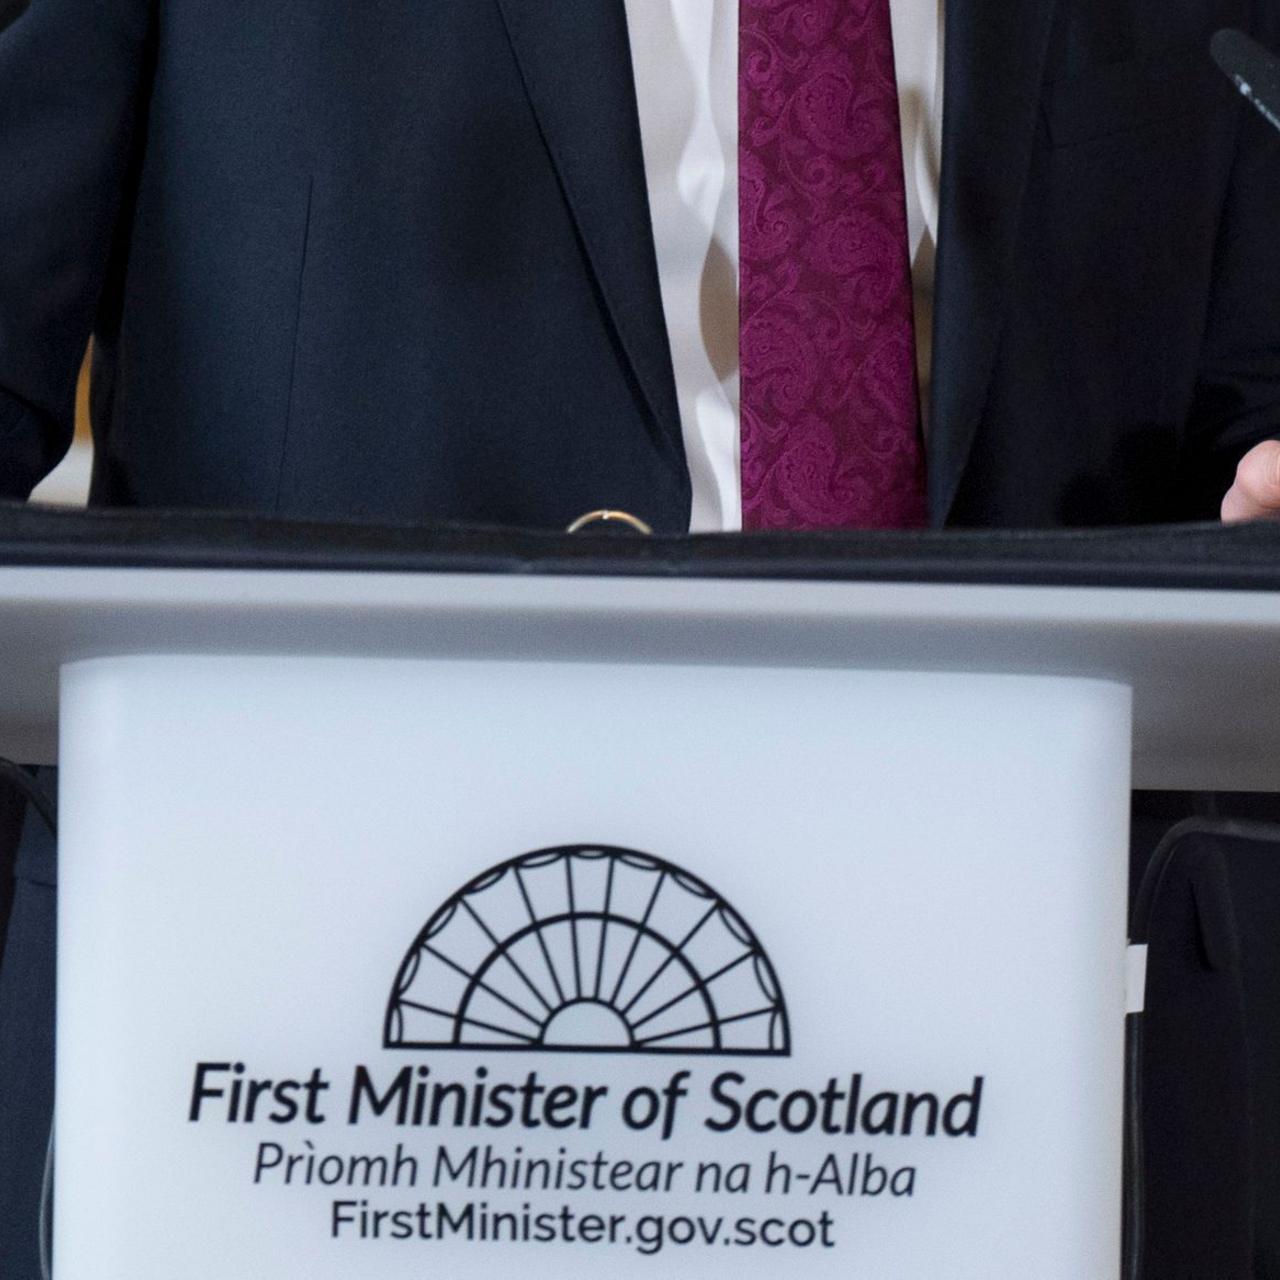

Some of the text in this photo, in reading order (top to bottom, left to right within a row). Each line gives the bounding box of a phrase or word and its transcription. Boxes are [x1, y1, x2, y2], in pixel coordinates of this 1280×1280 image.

[187, 1061, 985, 1141] First Minister of Scotland
[254, 1140, 916, 1197] Prìomh Mhinistear na h-Alba
[331, 1199, 835, 1256] FirstMinister.gov.scot
